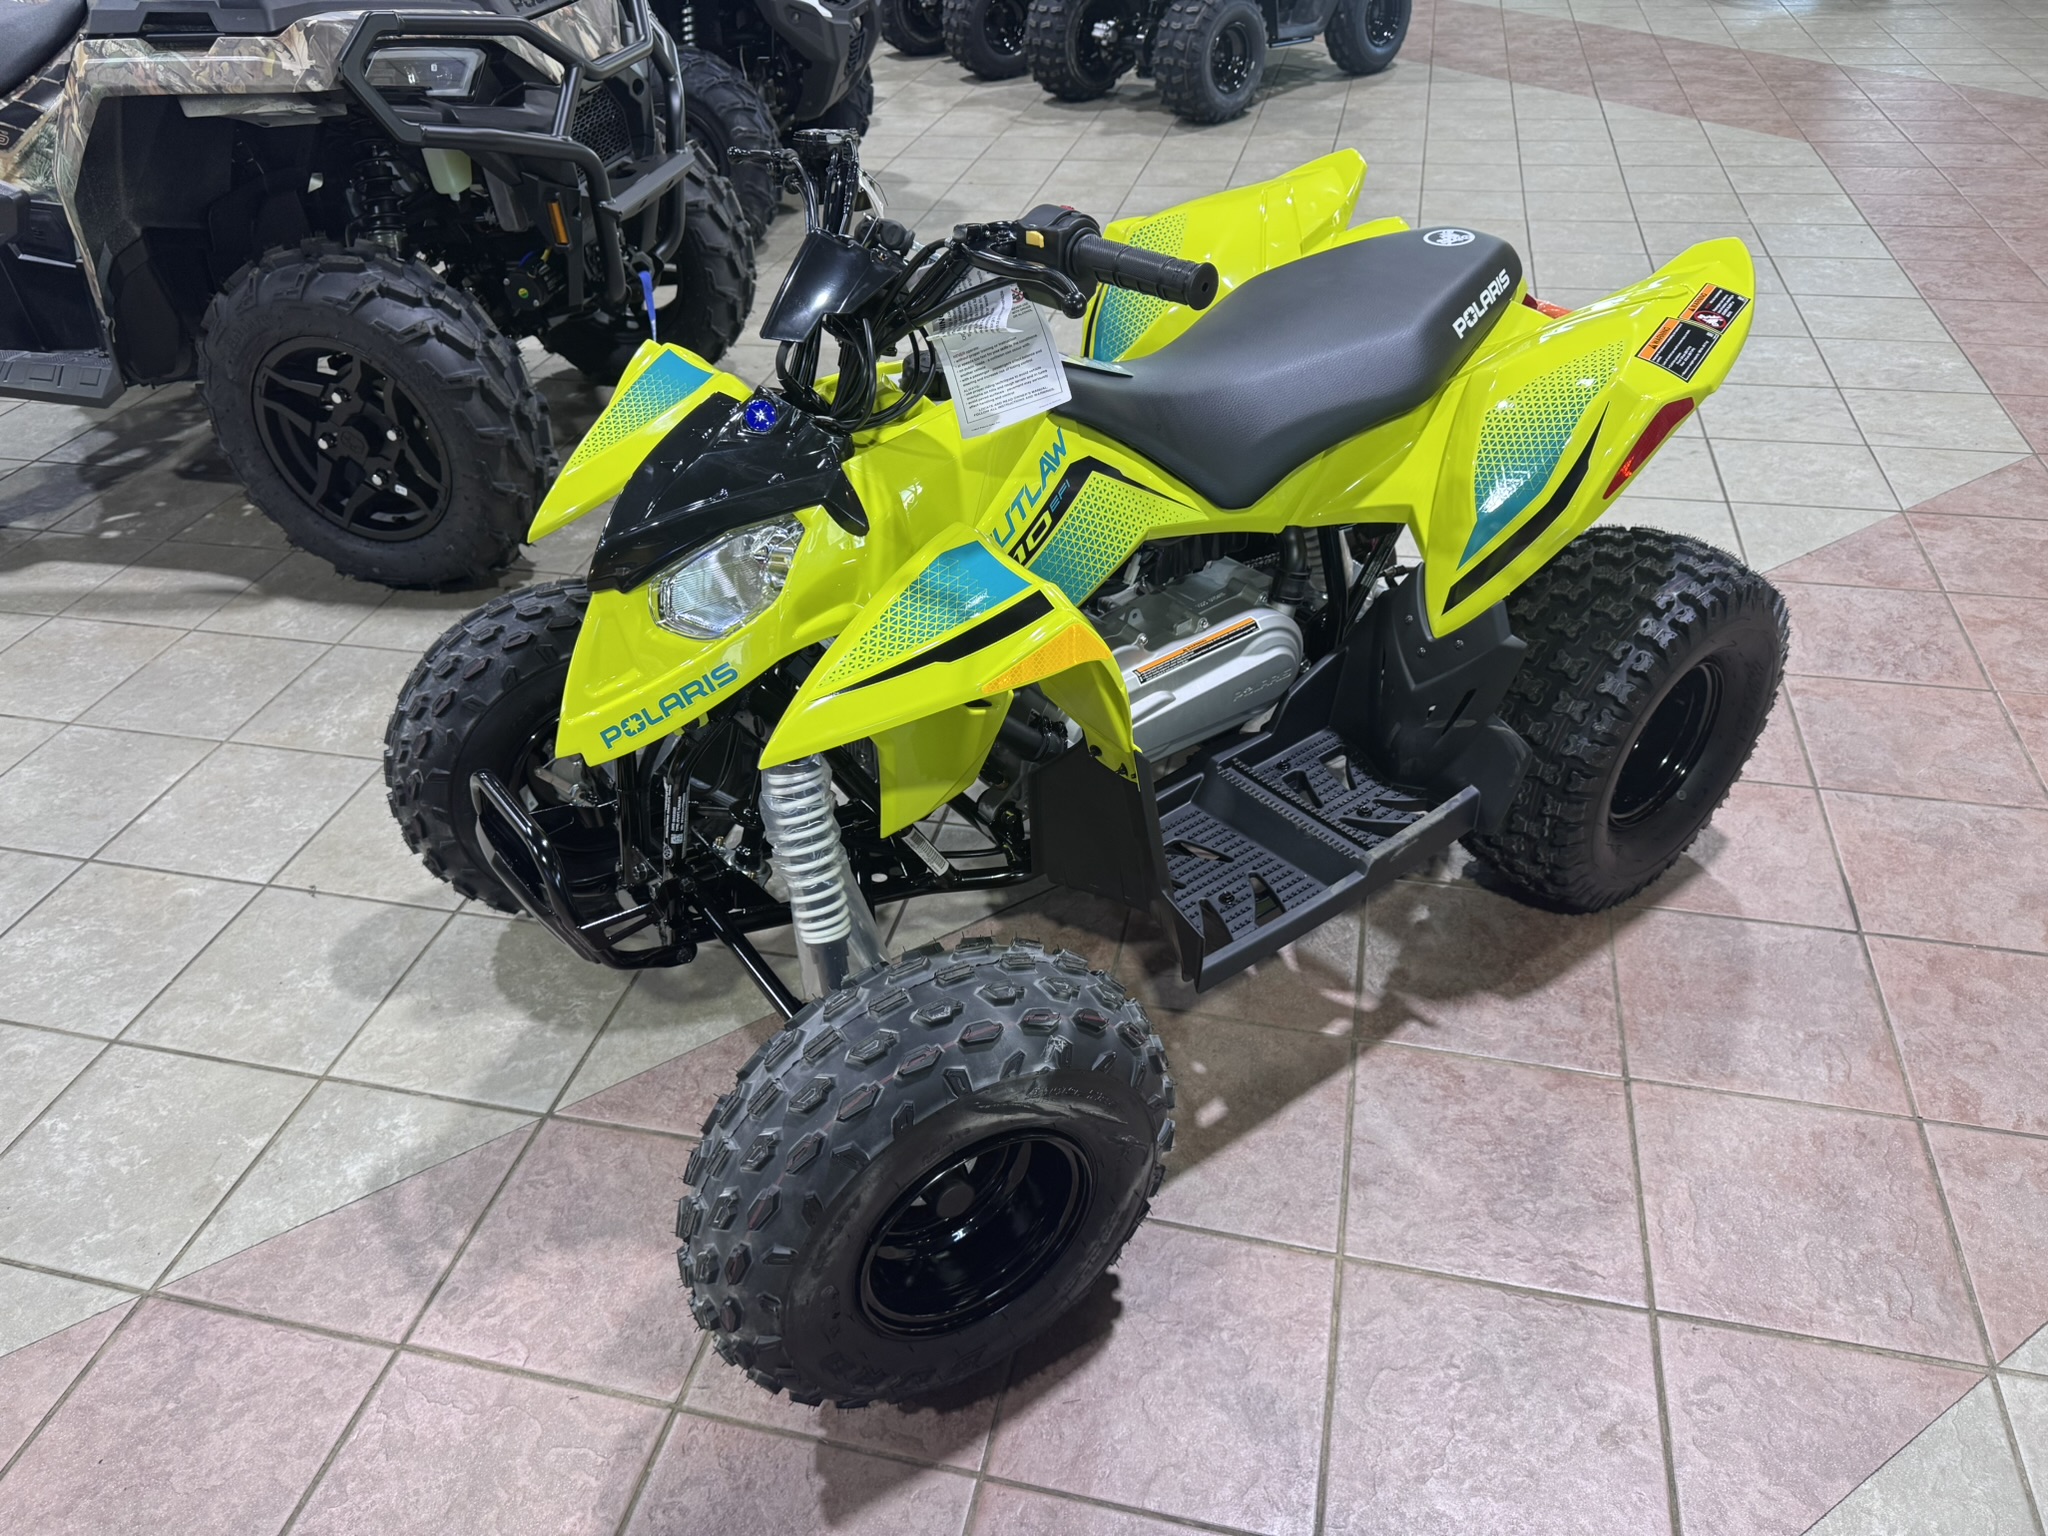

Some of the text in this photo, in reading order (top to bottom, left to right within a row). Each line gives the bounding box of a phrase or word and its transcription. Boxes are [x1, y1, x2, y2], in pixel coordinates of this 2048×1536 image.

[1452, 269, 1510, 339] POLARIS
[991, 426, 1067, 548] UTLAW
[1049, 479, 1070, 513] EFI
[600, 662, 738, 749] POLARIS
